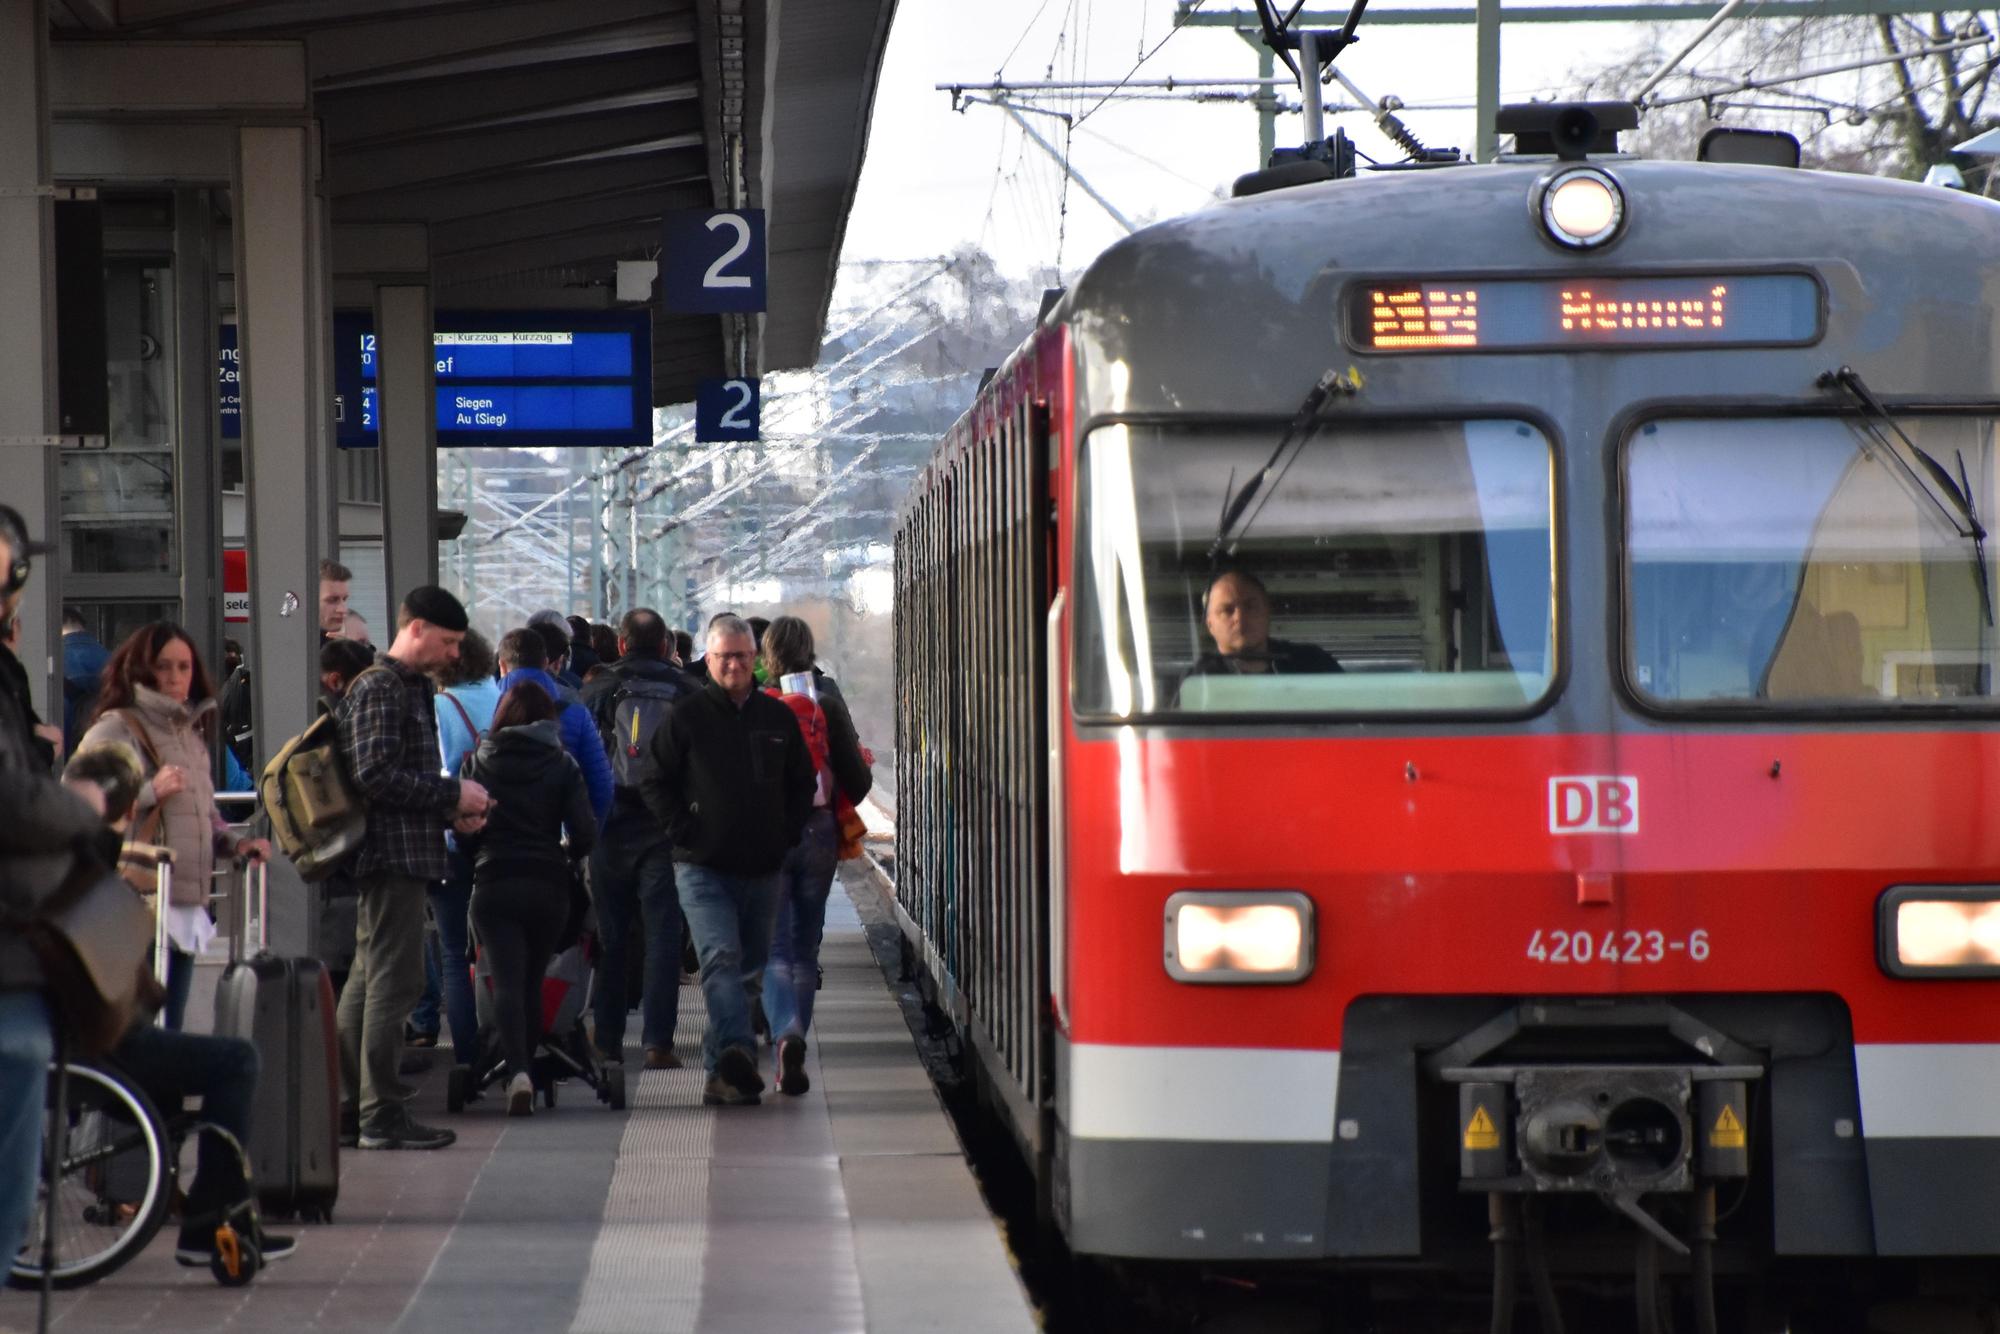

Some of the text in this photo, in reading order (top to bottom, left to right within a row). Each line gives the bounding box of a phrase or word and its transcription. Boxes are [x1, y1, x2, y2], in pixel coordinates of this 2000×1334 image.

[702, 213, 752, 288] 2
[457, 333, 499, 343] Kurzzug
[512, 333, 553, 343] Kurzzug
[434, 356, 454, 373] ef
[455, 396, 493, 410] Siegen
[719, 380, 752, 428] 2
[456, 412, 507, 427] Au (Sieg)
[1554, 780, 1634, 828] DB
[1527, 928, 1710, 963] 420 423-6
